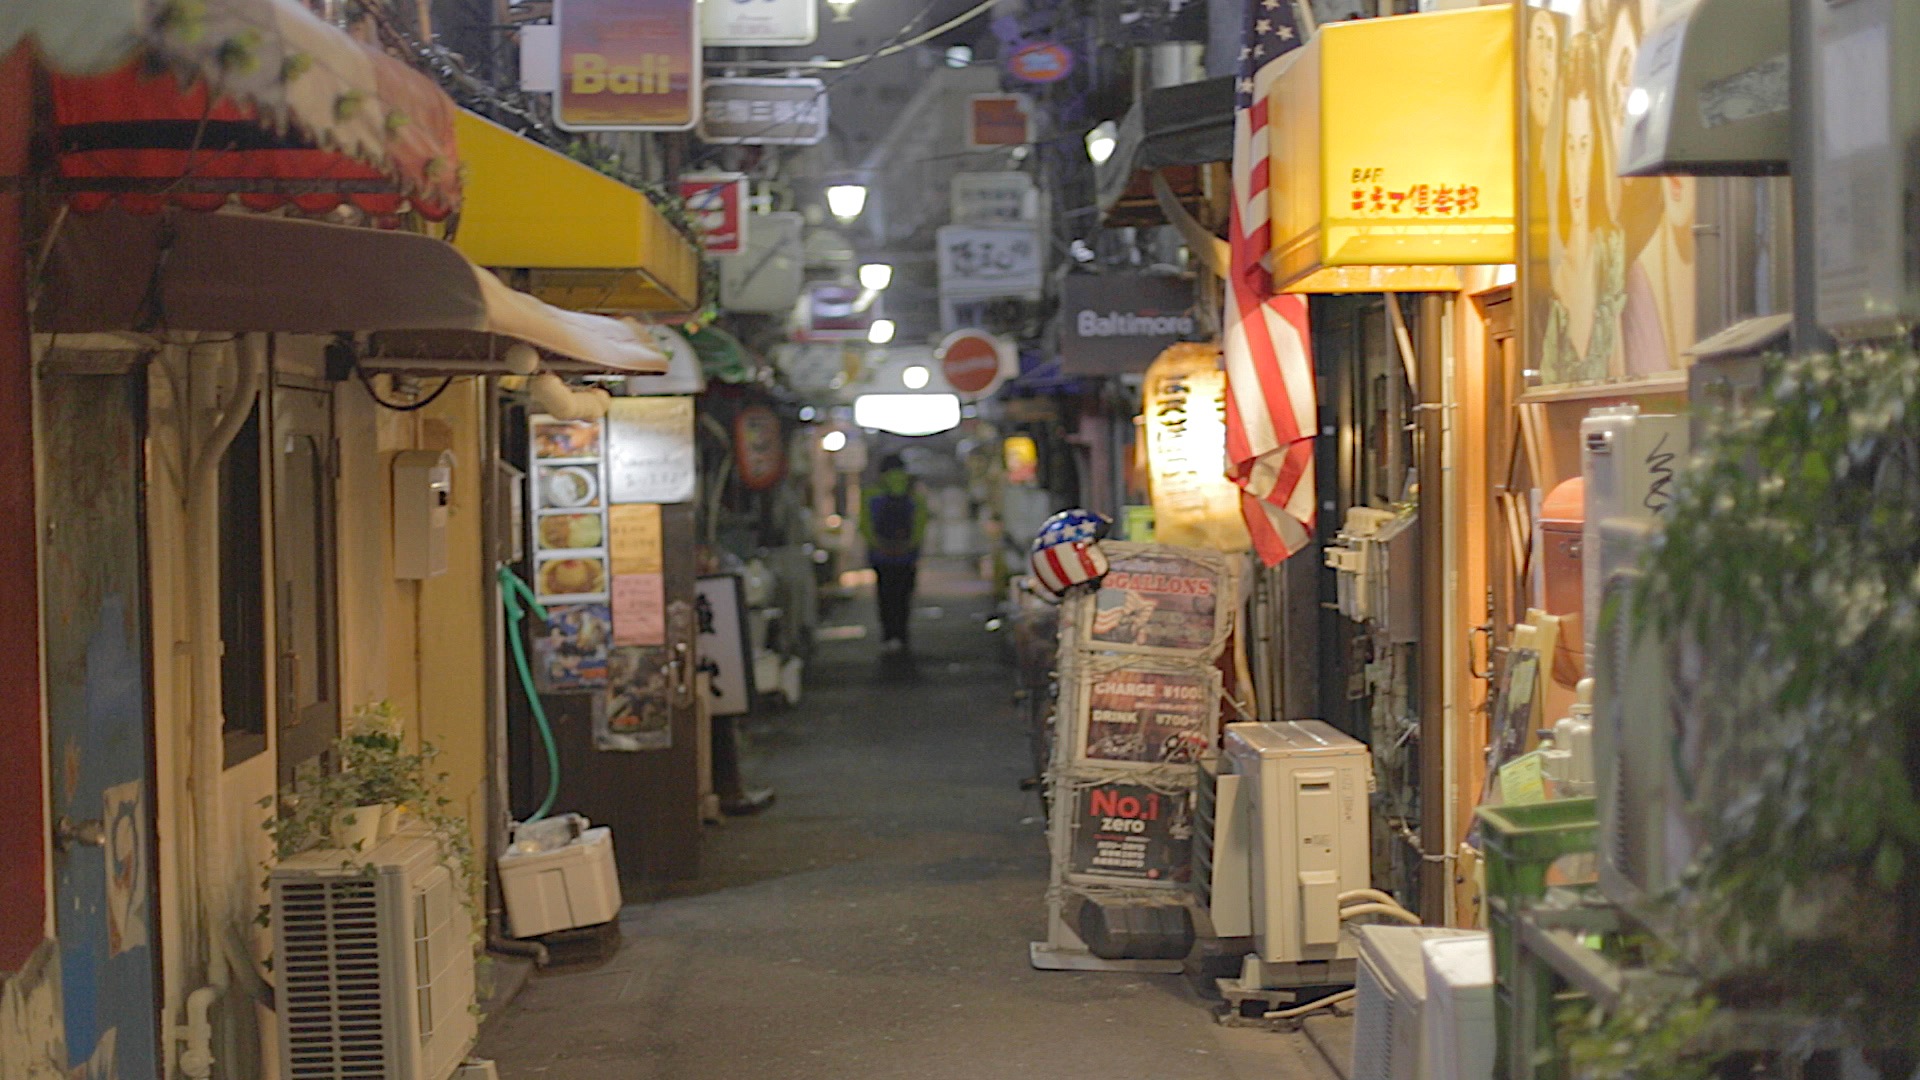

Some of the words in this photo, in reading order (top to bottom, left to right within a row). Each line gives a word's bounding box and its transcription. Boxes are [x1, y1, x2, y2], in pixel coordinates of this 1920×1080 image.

[571, 54, 671, 94] Bali
[1077, 309, 1194, 337] Baltimore
[1094, 682, 1156, 698] CHARGE
[1089, 788, 1159, 821] No.1
[1100, 817, 1145, 834] zero
